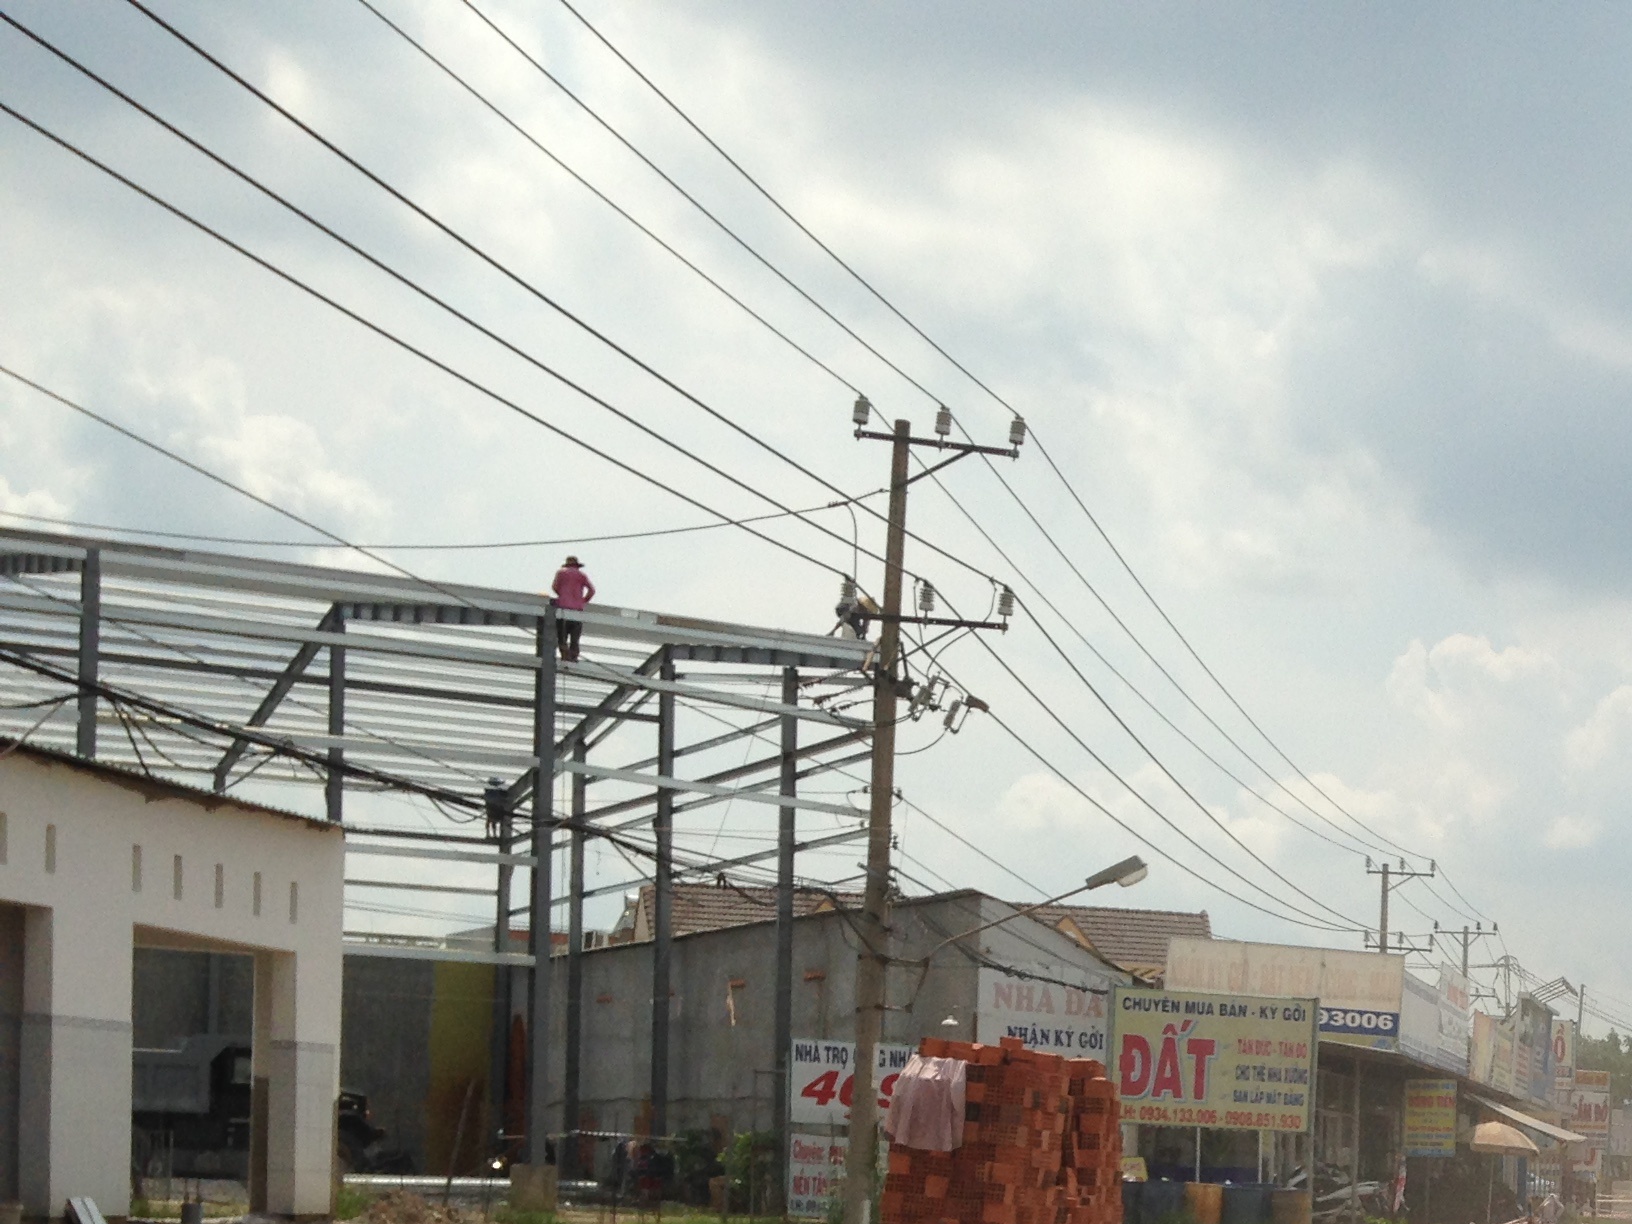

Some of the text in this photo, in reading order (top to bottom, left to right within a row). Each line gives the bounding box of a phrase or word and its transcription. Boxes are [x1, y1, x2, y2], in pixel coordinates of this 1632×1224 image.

[1122, 996, 1180, 1013] CHUYÊN
[1184, 1001, 1214, 1015] MUA
[1219, 999, 1247, 1017] BÁN
[824, 1045, 849, 1069] TRỌ
[1118, 1019, 1216, 1100] ĐẤT
